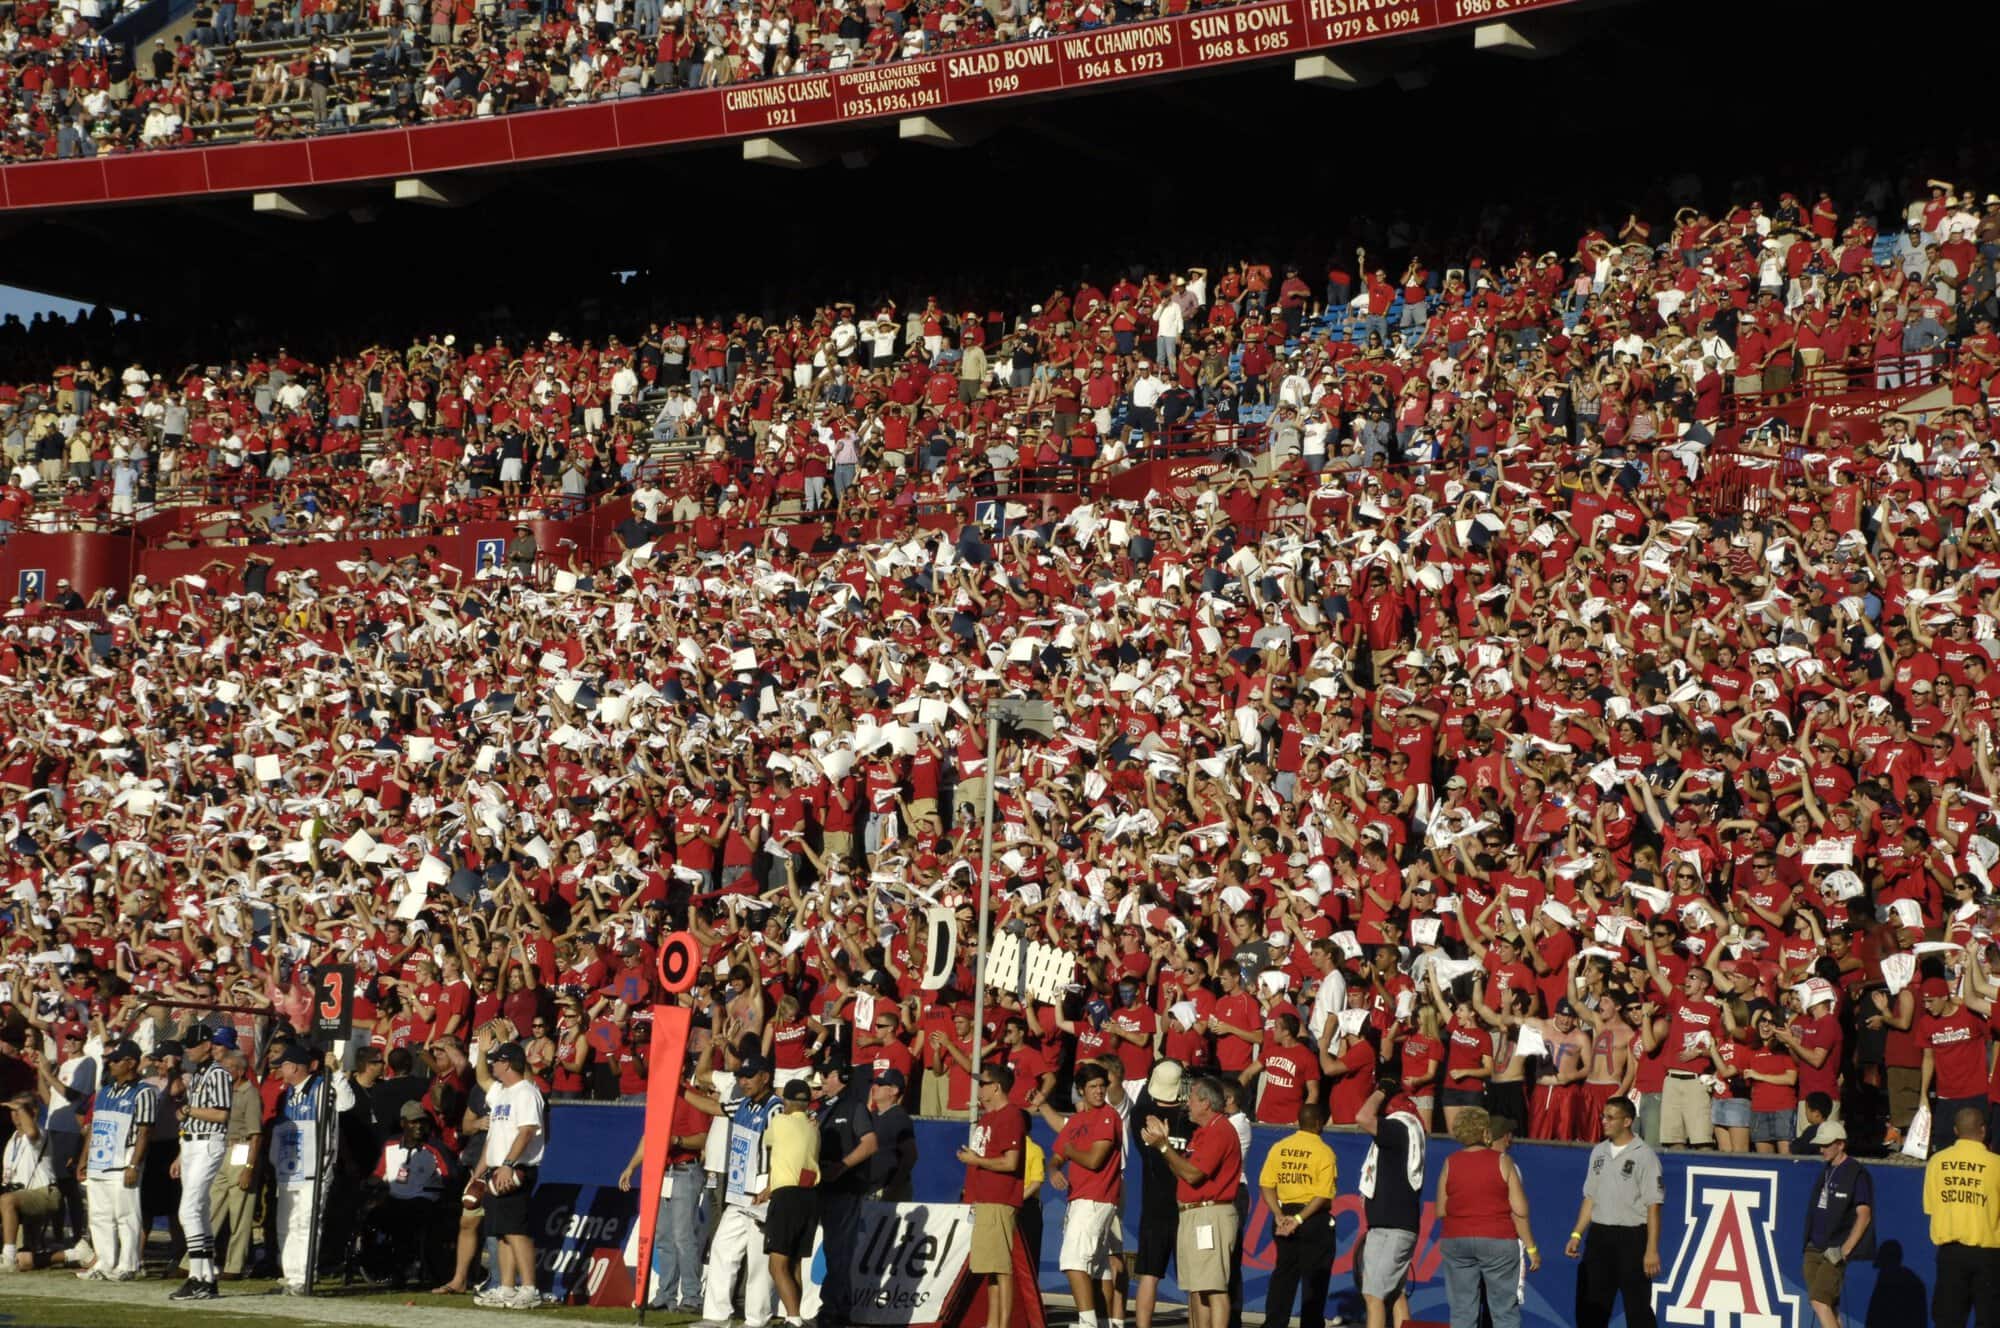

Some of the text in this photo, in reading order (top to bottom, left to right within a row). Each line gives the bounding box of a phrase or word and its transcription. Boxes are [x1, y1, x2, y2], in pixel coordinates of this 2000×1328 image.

[1190, 4, 1293, 40] SUN BOWL
[1326, 8, 1420, 40] 1979 & 1994
[1064, 24, 1172, 61] WAC CHAMPIONS
[1198, 31, 1289, 61] 1968 & 1985
[840, 61, 937, 86] BORDER CONFERENCE
[948, 44, 1054, 79] SALAD BOWL
[1077, 51, 1164, 80] 1964 & 1973
[726, 78, 832, 111] CHRISTMAS CLASSIC
[858, 75, 921, 95] CHAMPIONS
[987, 74, 1019, 94] 1949
[766, 107, 797, 126] 1921
[843, 88, 942, 117] 1935,1936,1941
[982, 503, 998, 528] 4
[1884, 748, 1904, 774] 7
[920, 907, 957, 990] D
[320, 972, 343, 1020] 3
[1280, 1148, 1312, 1159] EVENT
[1941, 1161, 1987, 1174] EVENT
[1944, 1176, 1982, 1188] STAFF
[1941, 1190, 1988, 1207] SECURITY
[545, 1205, 619, 1240] Game
